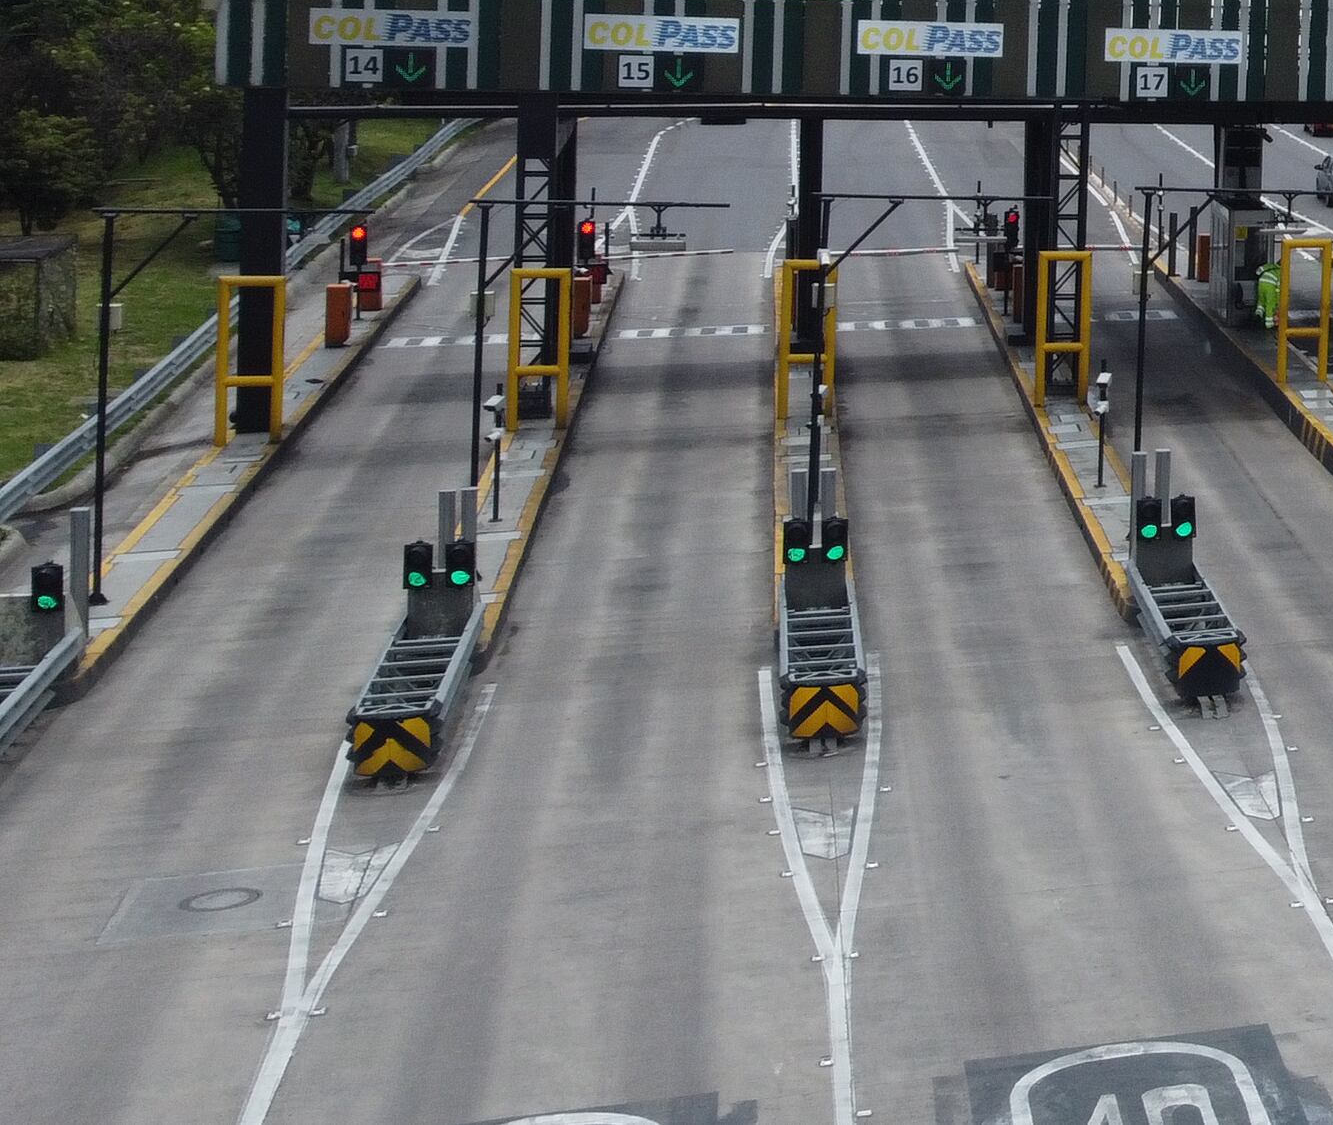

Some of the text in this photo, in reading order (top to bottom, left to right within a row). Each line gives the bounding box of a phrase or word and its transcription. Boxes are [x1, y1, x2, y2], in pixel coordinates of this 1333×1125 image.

[348, 55, 380, 76] 14
[621, 61, 651, 81] 15
[893, 65, 918, 85] 16
[1139, 72, 1164, 91] 17
